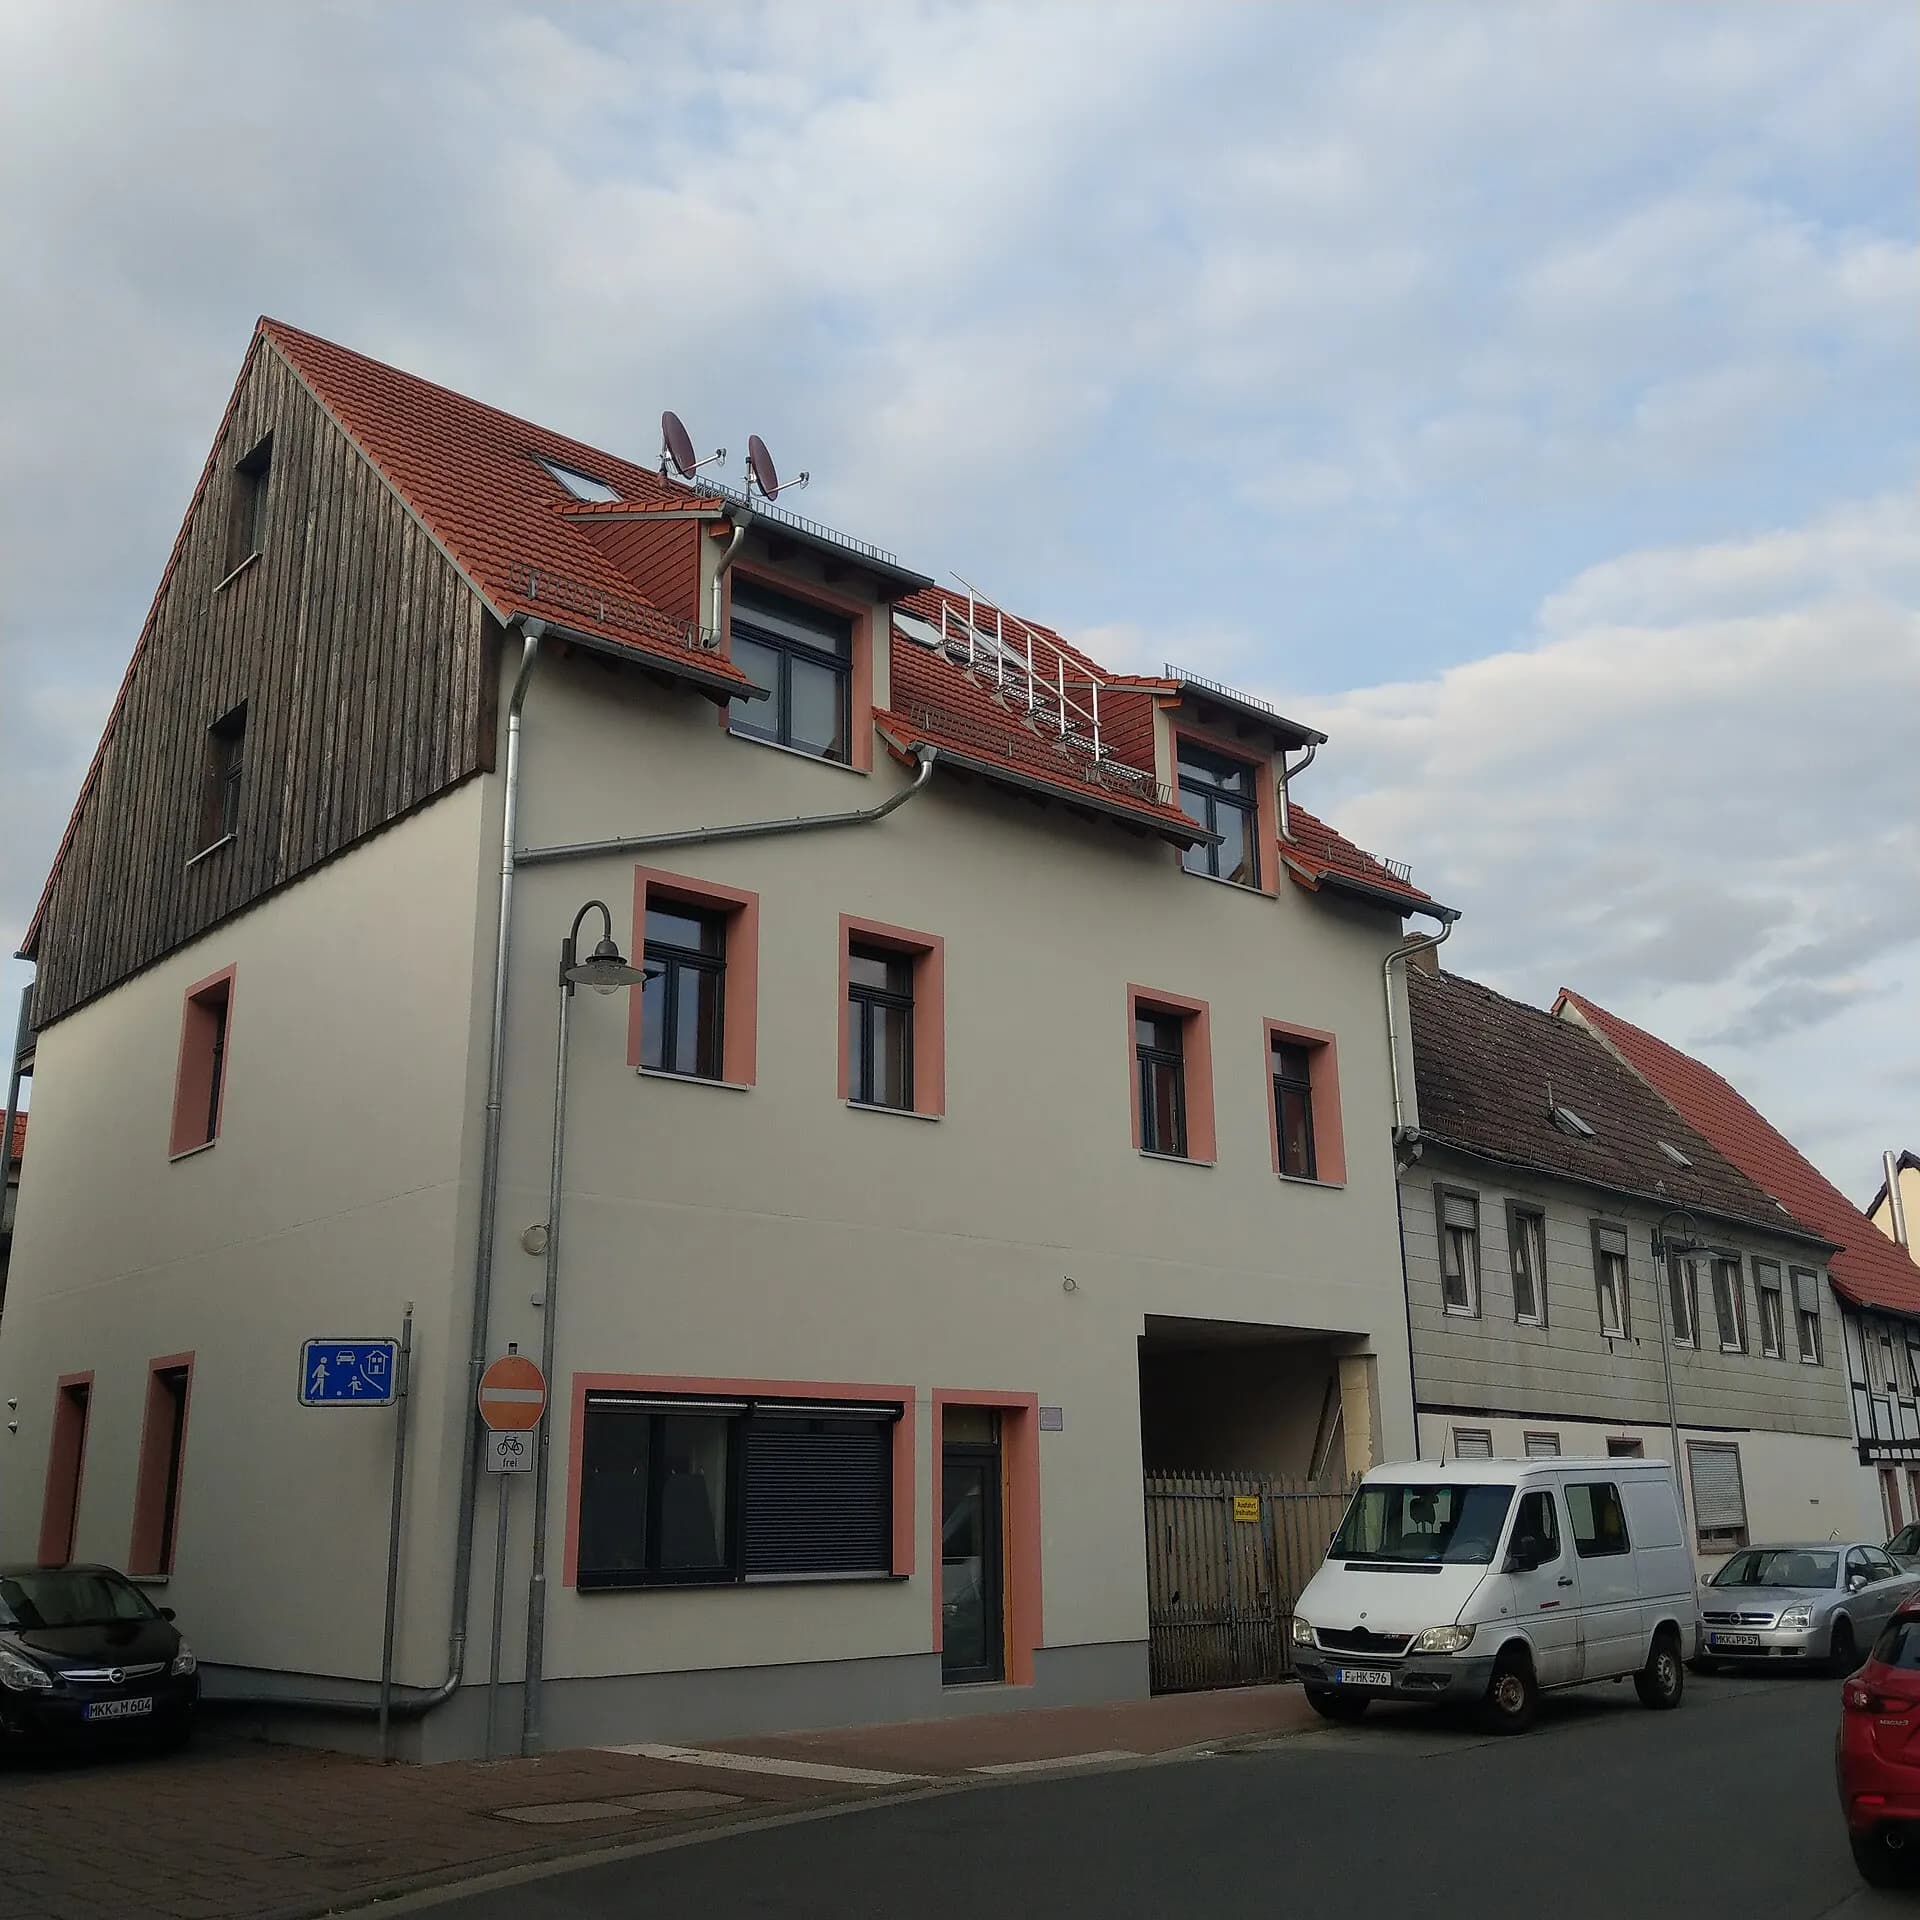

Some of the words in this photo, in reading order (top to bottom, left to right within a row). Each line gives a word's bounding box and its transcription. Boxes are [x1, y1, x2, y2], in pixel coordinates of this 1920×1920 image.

[502, 1457, 518, 1467] frei
[1369, 1672, 1387, 1684] 576
[89, 1703, 113, 1717] MKK
[120, 1701, 129, 1713] M
[130, 1699, 151, 1712] 604
